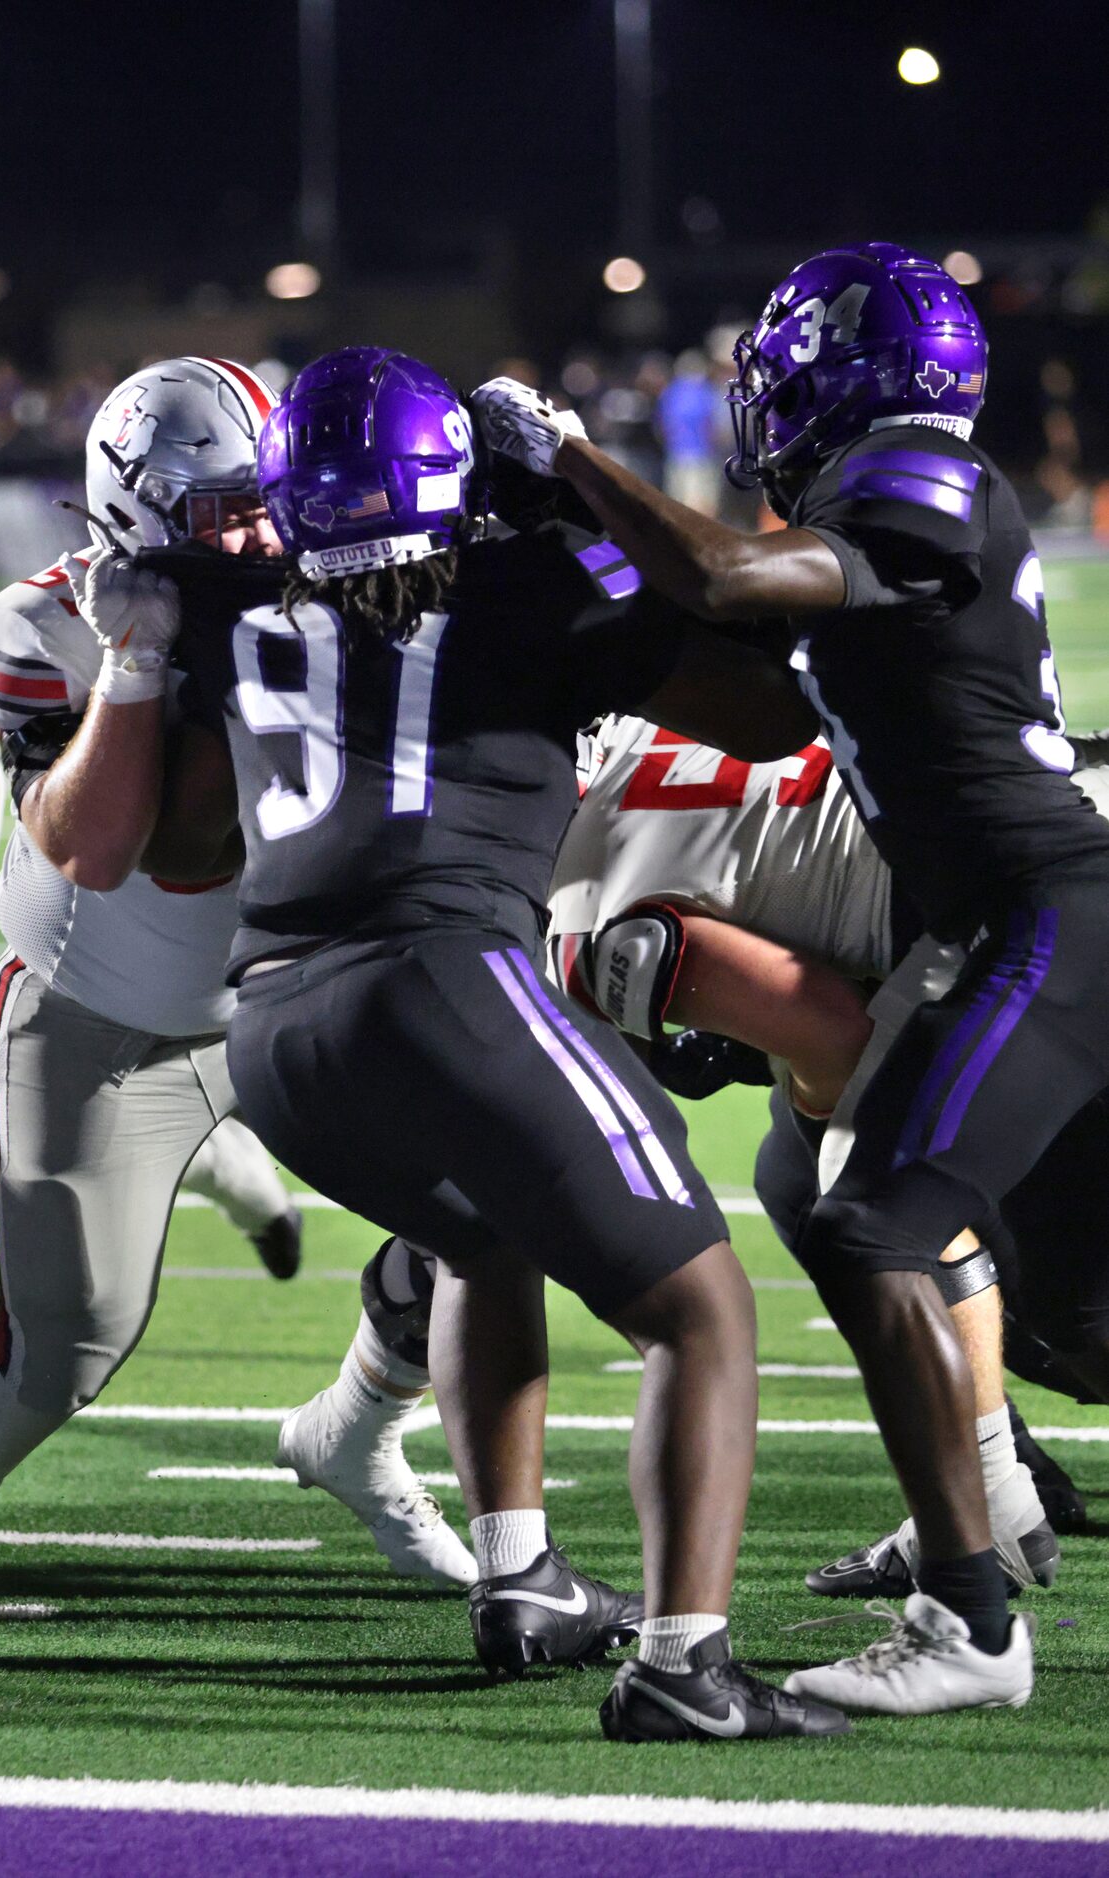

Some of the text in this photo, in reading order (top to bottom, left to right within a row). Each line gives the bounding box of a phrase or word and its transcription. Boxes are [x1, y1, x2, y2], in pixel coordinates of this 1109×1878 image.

[790, 282, 872, 363] 34
[910, 415, 958, 433] COYOTE
[319, 539, 393, 567] COYOTE U
[231, 600, 453, 842] 91
